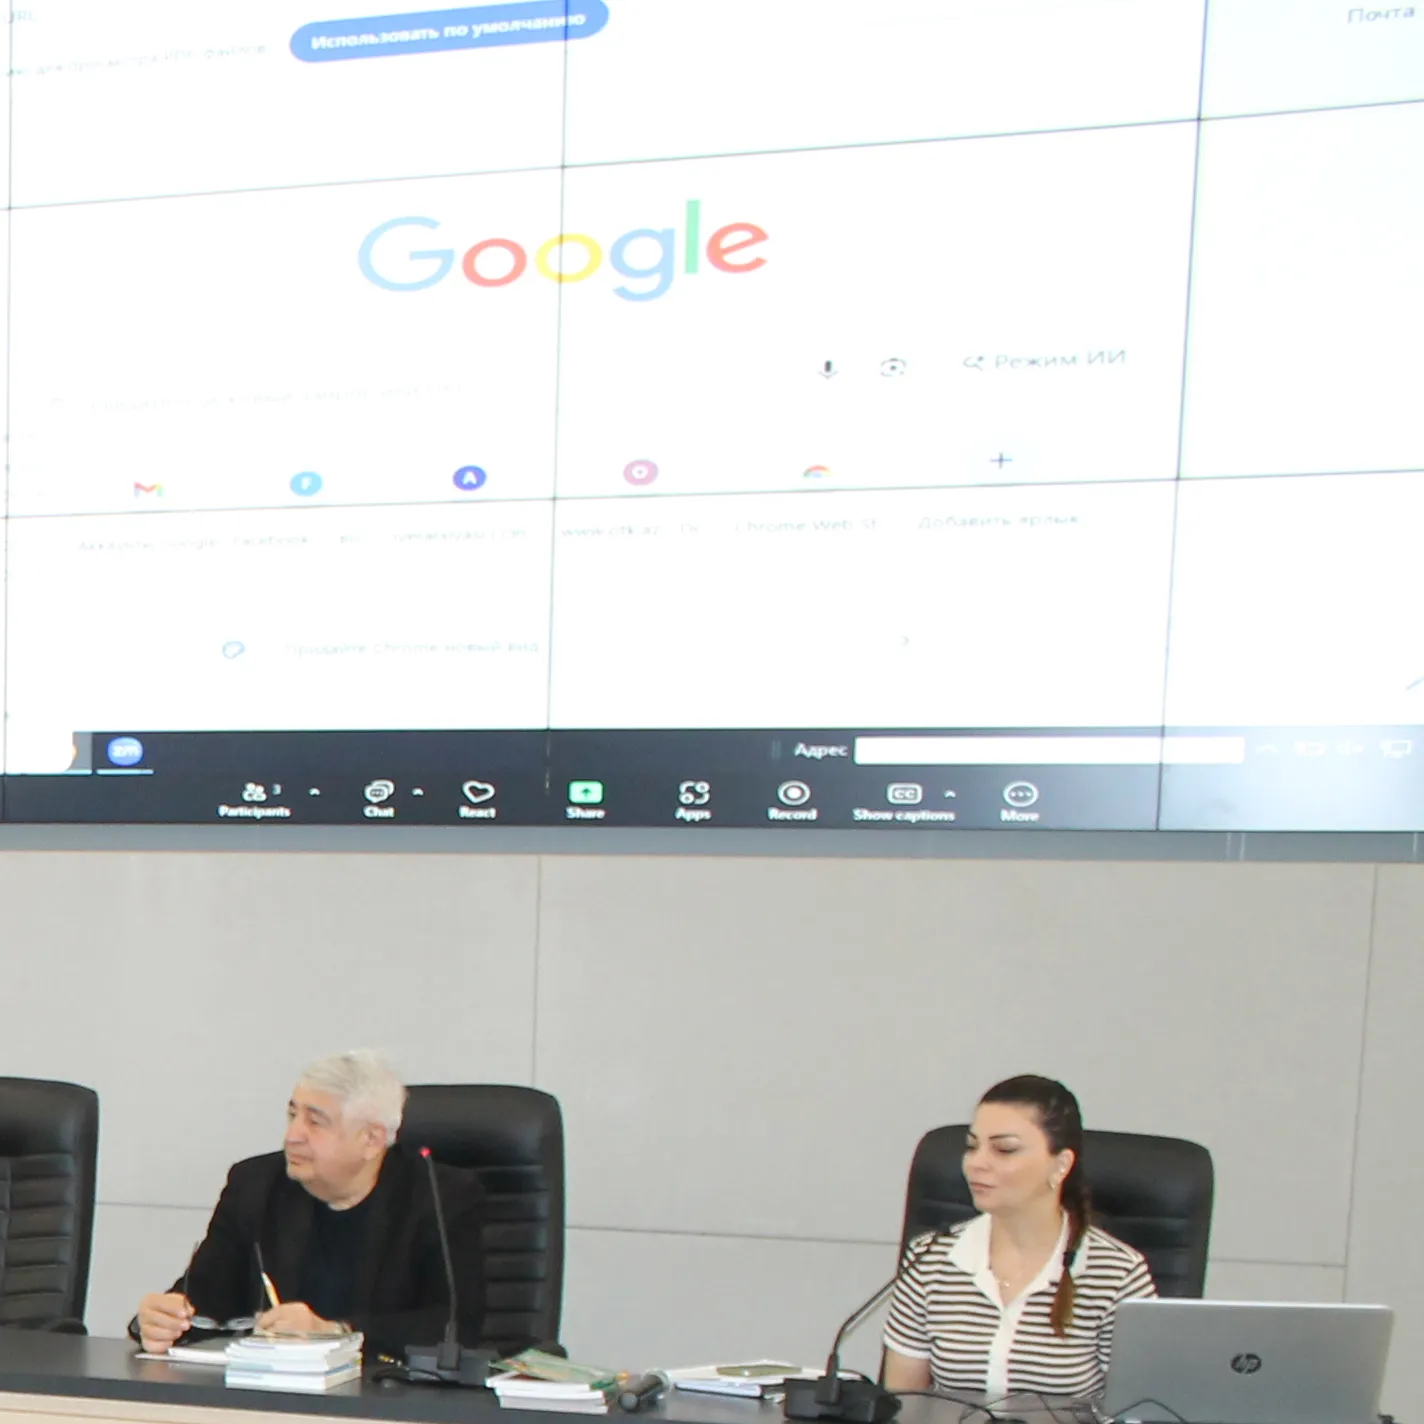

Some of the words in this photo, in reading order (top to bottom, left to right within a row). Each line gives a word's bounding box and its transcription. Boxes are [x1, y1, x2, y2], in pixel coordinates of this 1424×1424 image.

[1347, 7, 1416, 25] Почта
[310, 27, 440, 50] Использовать
[443, 24, 468, 38] по
[471, 13, 587, 39] умолчанию
[357, 198, 770, 303] Google
[994, 352, 1078, 370] Режим
[1086, 348, 1127, 366] ИИ
[793, 741, 849, 760] Адрес
[218, 804, 292, 819] Participants
[363, 805, 395, 818] Chat
[459, 805, 497, 818] React
[565, 806, 606, 820] Share
[675, 807, 712, 822] Apps
[767, 806, 818, 821] Record
[852, 807, 894, 821] Show
[894, 808, 956, 823] captions
[1001, 807, 1040, 821] More
